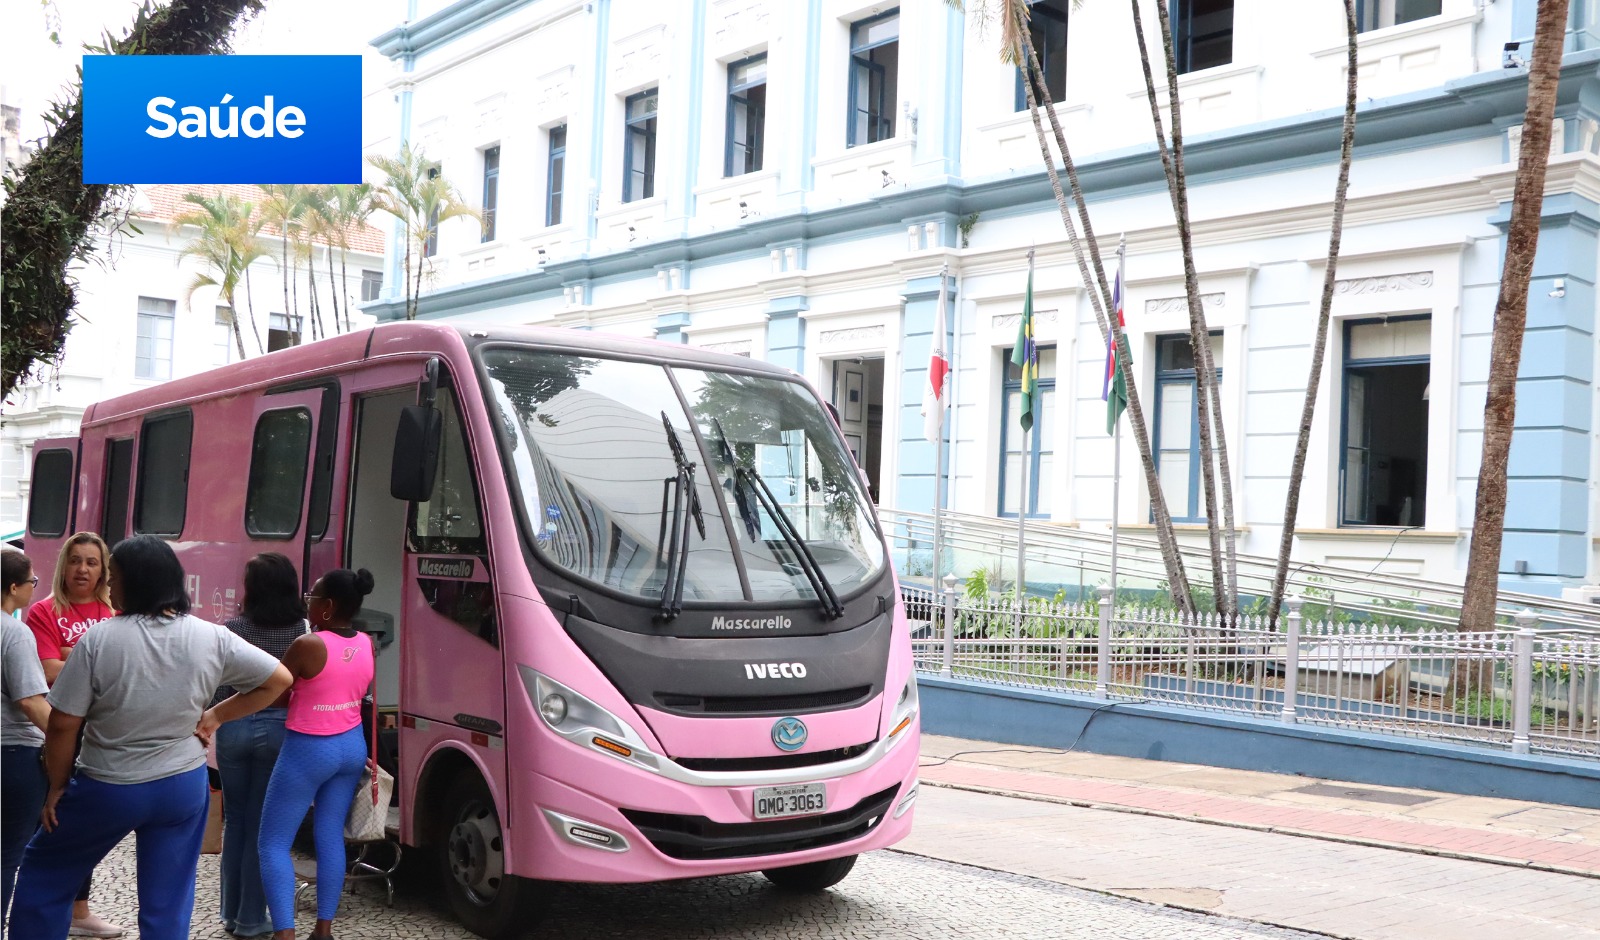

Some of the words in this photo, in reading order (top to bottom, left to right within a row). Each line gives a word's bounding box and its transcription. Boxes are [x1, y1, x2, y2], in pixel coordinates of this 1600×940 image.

[420, 559, 471, 577] Mascarello
[711, 615, 792, 630] Mascarello
[744, 663, 807, 679] IVECO
